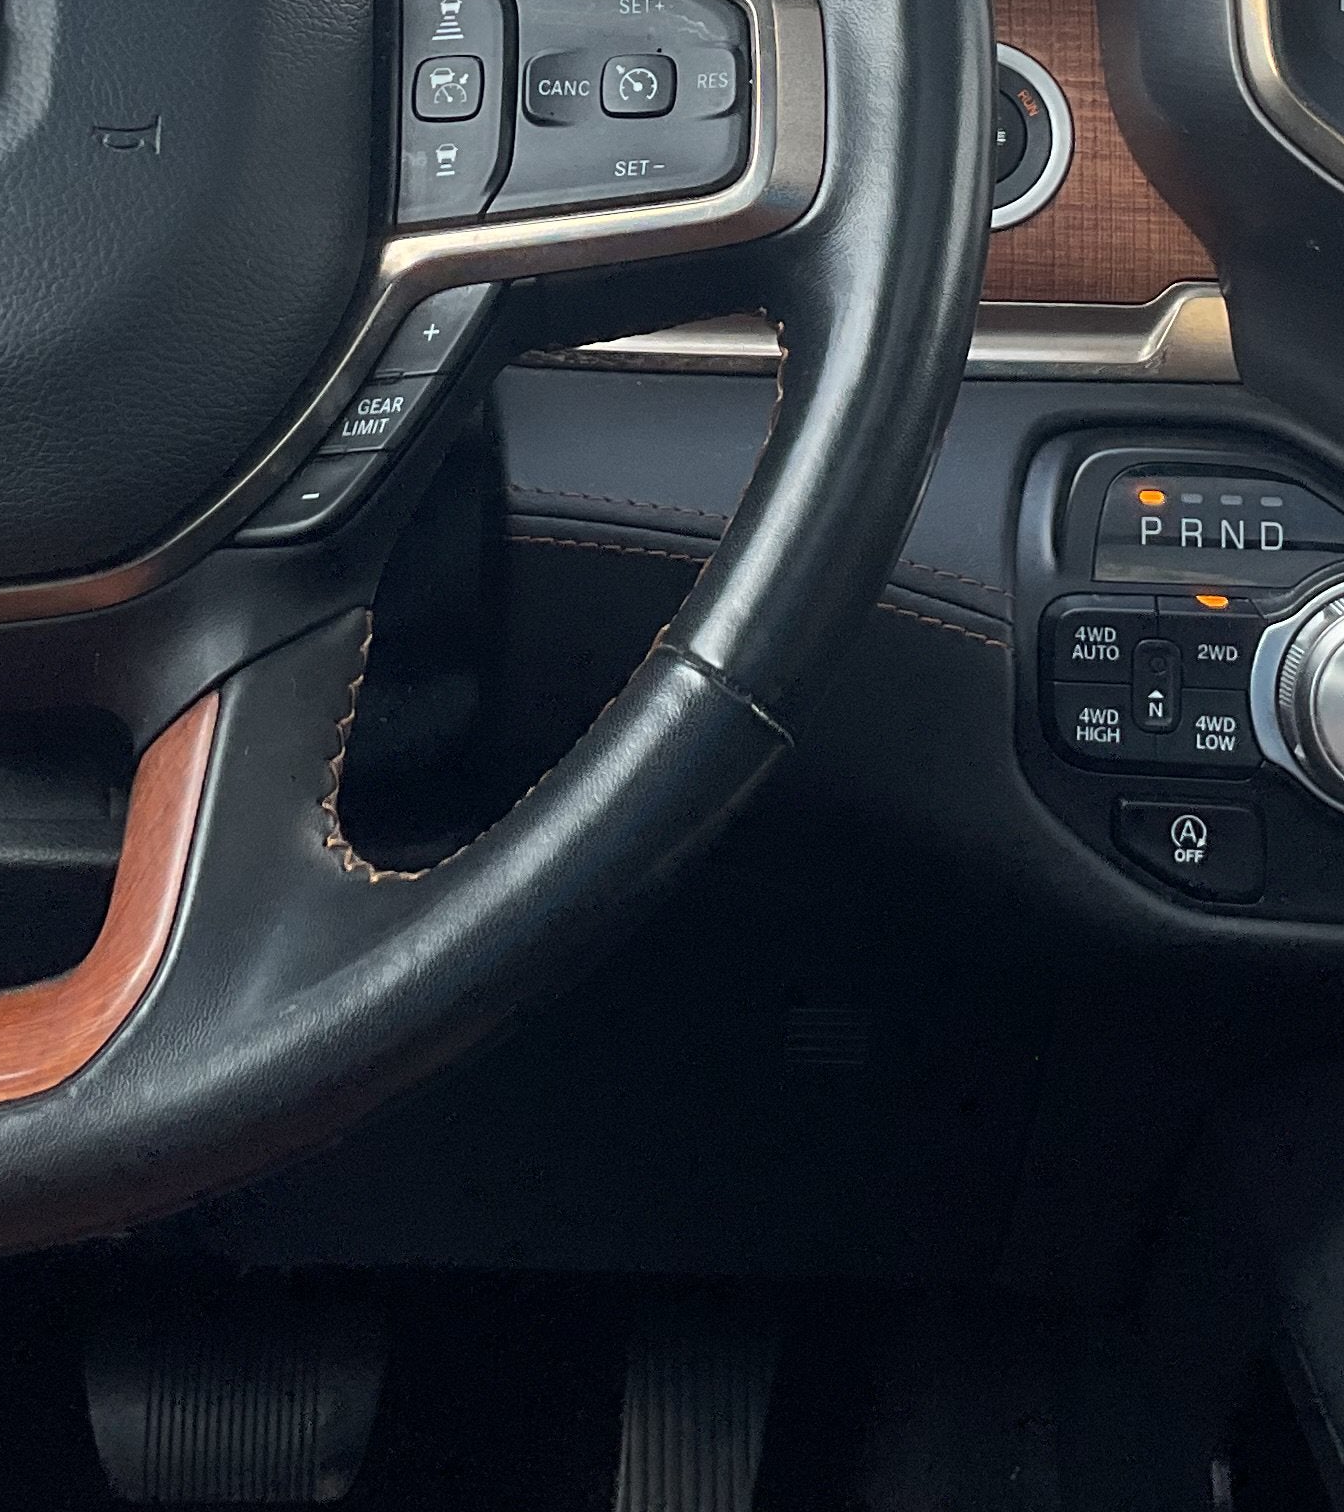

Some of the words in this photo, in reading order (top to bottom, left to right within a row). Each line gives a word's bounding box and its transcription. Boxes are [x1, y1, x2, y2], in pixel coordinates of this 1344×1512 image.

[538, 80, 590, 96] CANC
[698, 73, 728, 88] RES
[1017, 90, 1038, 117] RUN
[358, 396, 404, 415] GEAR
[342, 418, 389, 436] LIMIT
[1142, 517, 1162, 545] P
[1182, 518, 1202, 547] R
[1221, 520, 1244, 549] N
[1260, 522, 1285, 550] D
[1075, 626, 1116, 642] 4WD
[1072, 645, 1119, 660] AUTO
[1198, 644, 1238, 661] 2WD
[1079, 708, 1118, 724] 4WD
[1149, 702, 1162, 717] N
[1196, 716, 1235, 732] 4WD
[1077, 726, 1120, 743] HIGH
[1197, 731, 1235, 751] LOW
[1175, 848, 1203, 863] OFF
